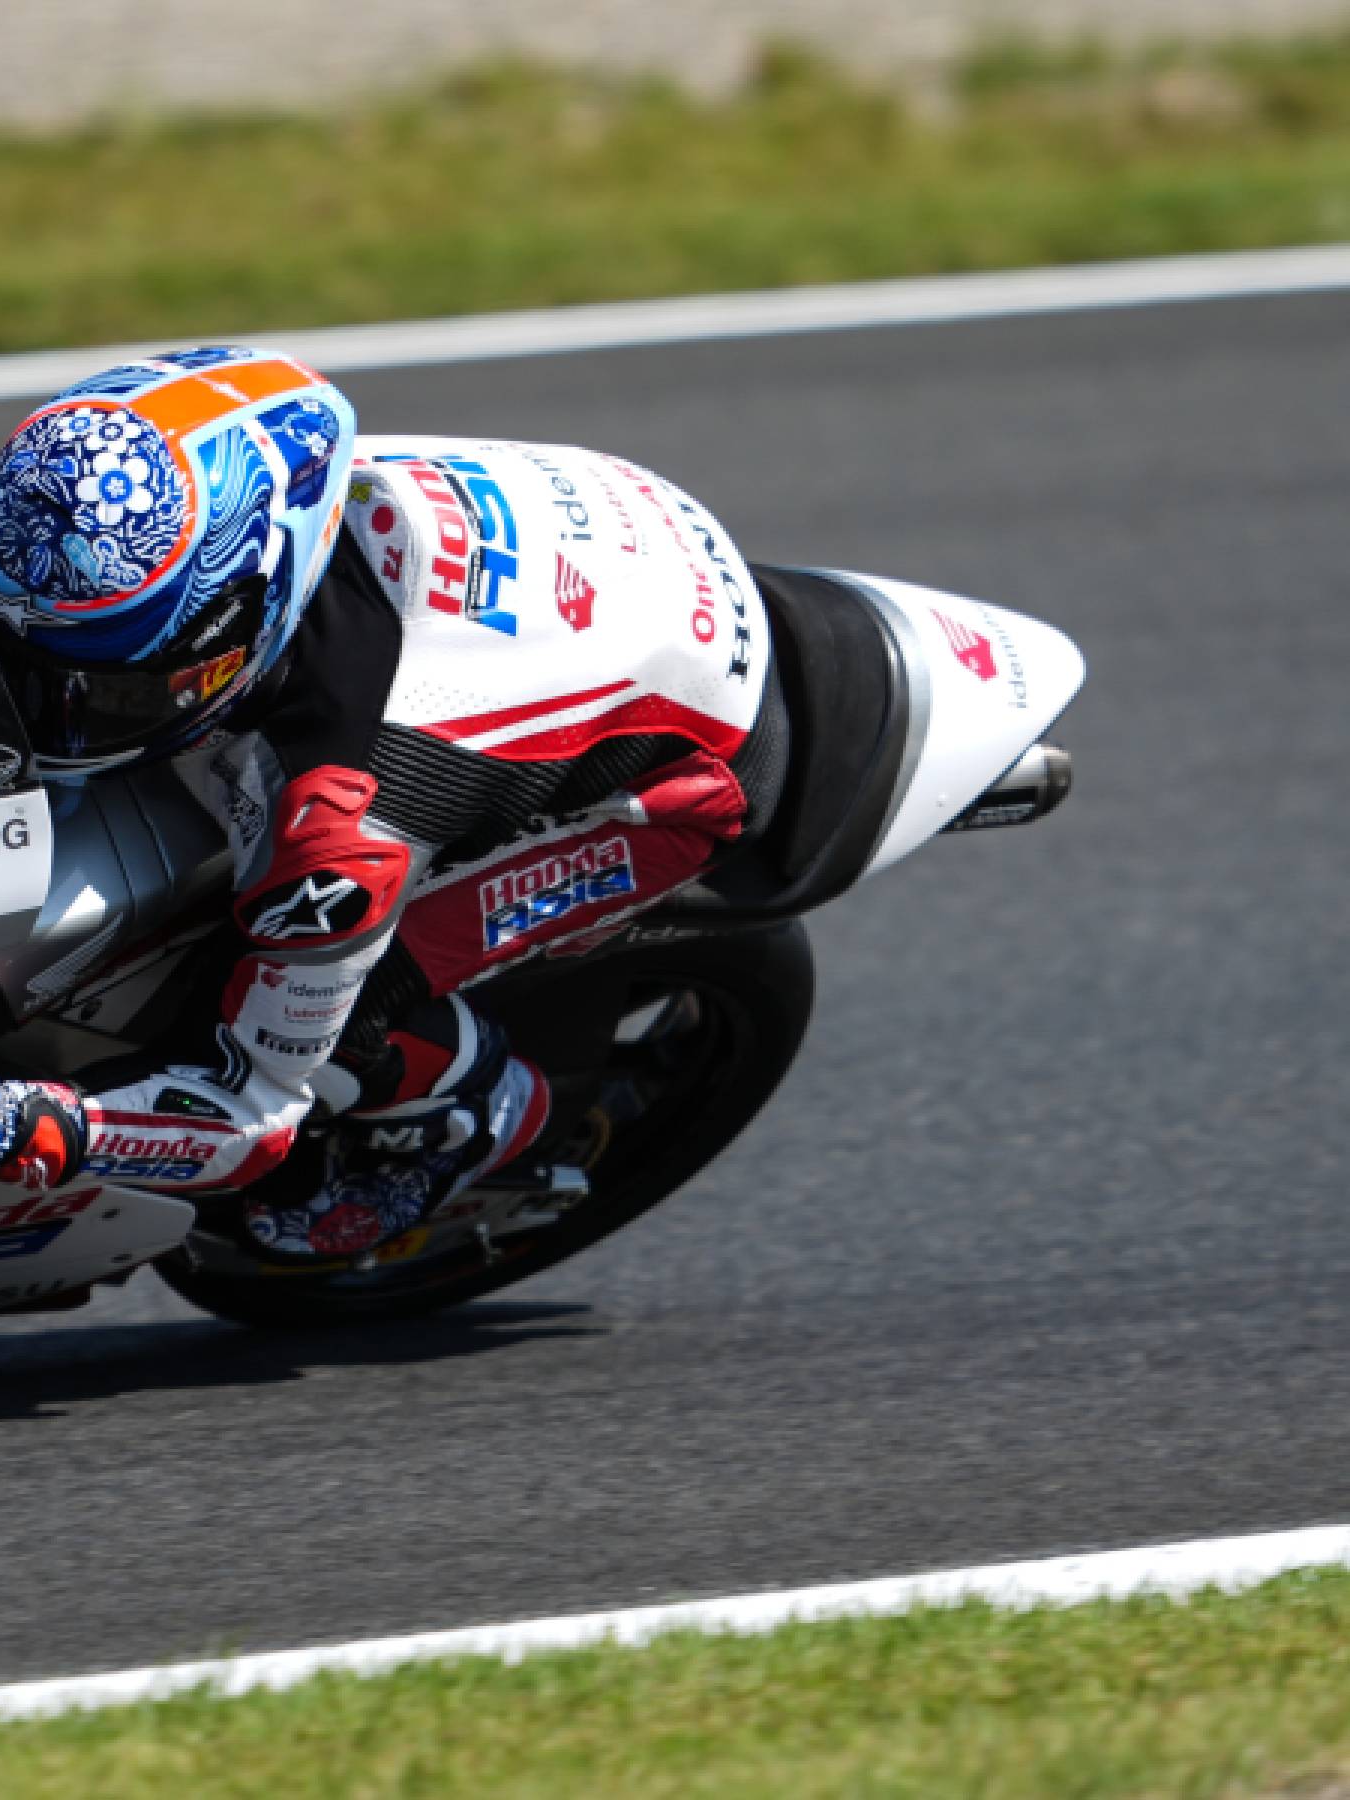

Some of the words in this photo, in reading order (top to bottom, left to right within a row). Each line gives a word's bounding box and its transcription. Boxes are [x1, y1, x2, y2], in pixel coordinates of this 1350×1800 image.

[352, 456, 469, 616] Hon
[480, 836, 627, 912] Honda
[90, 1133, 217, 1160] Honda
